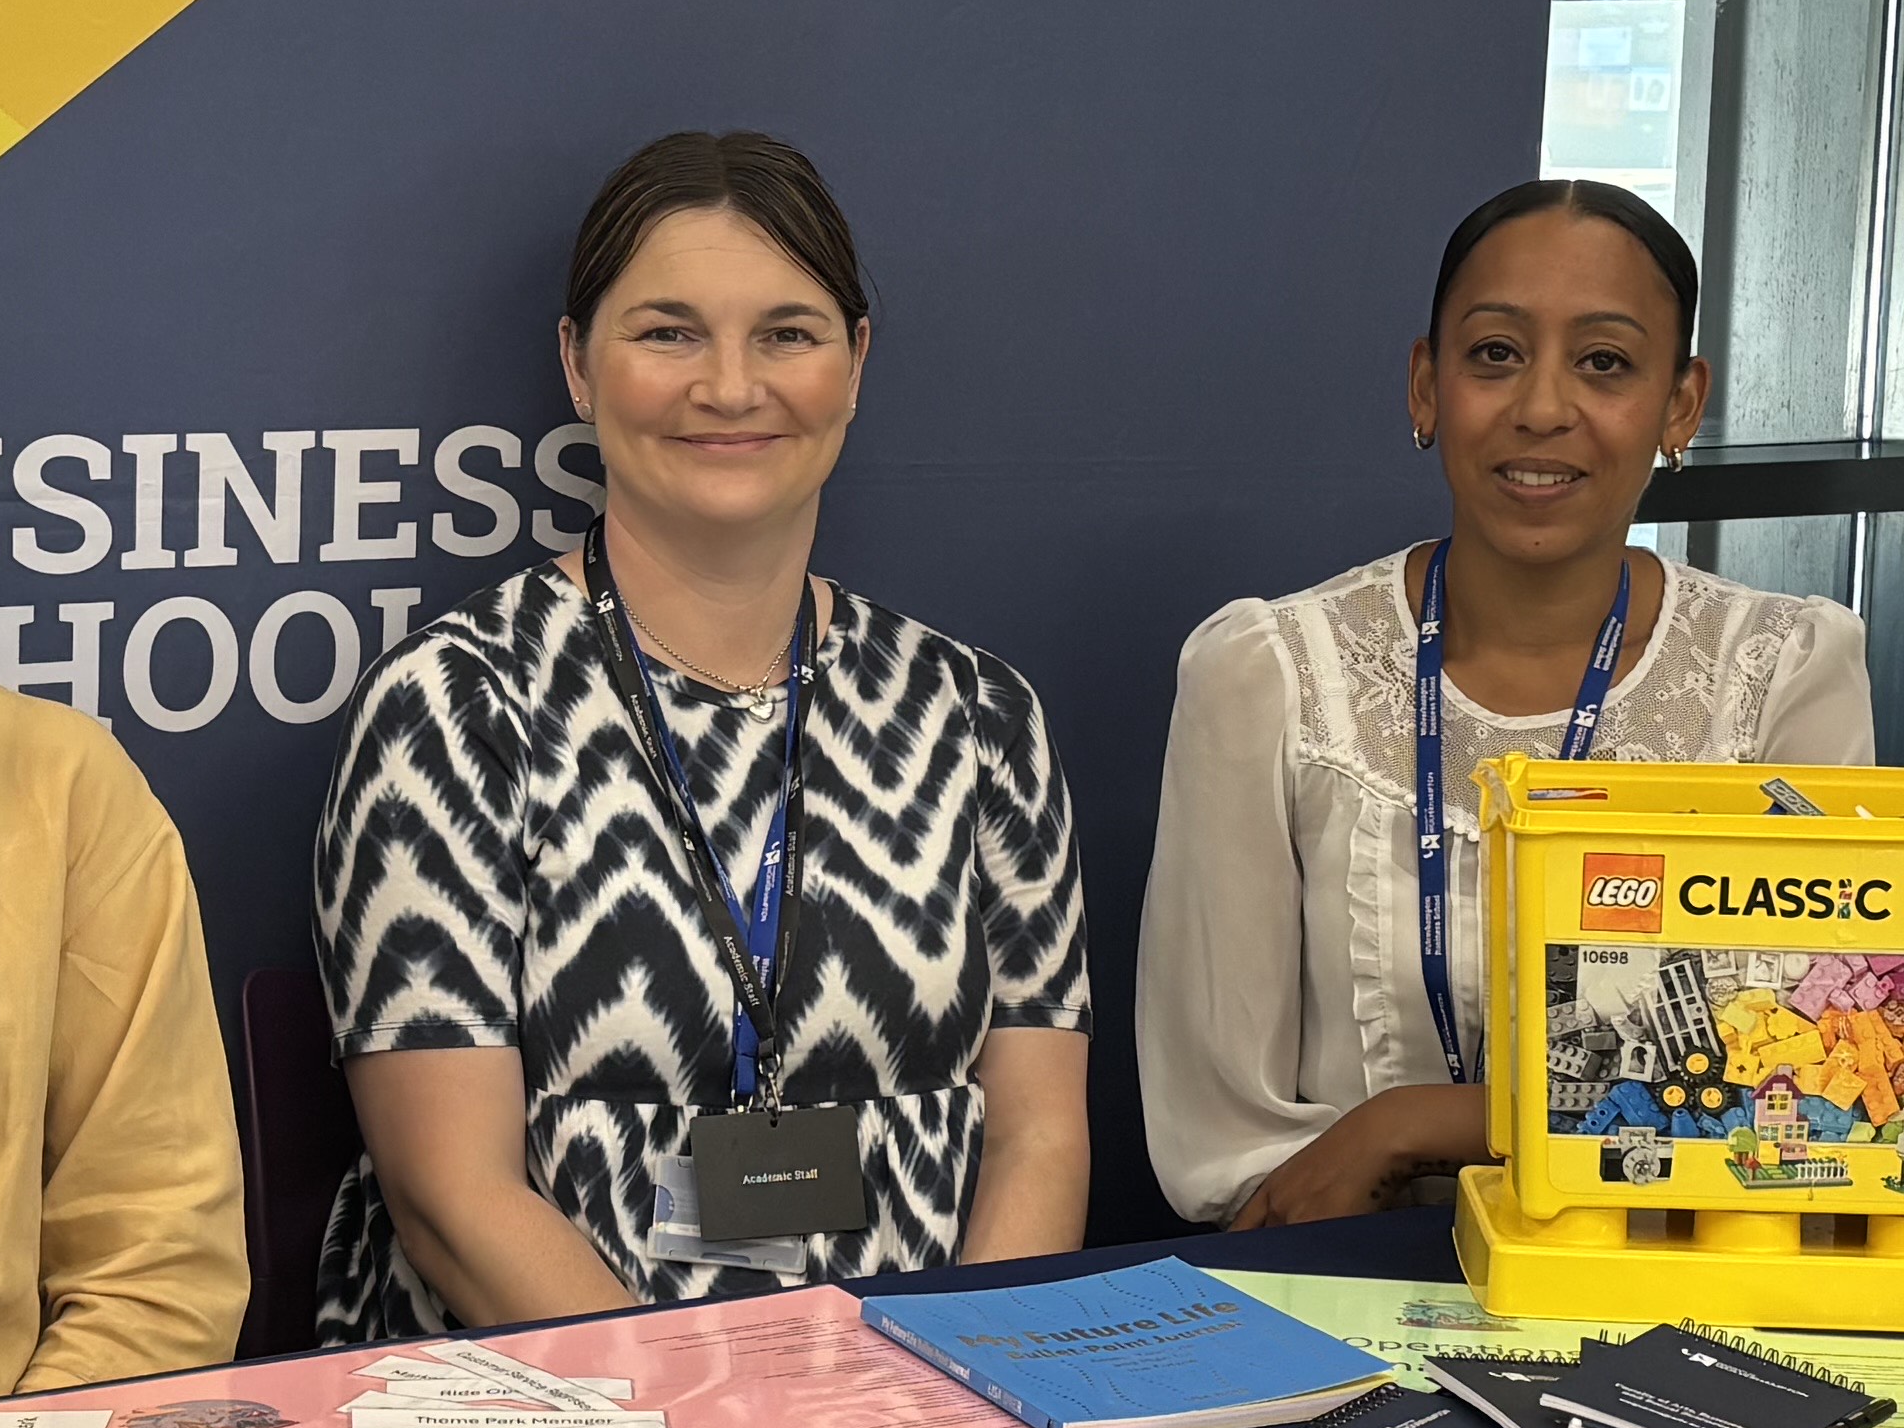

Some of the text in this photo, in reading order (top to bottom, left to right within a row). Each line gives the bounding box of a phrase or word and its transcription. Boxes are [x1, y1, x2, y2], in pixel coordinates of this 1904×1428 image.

[1587, 872, 1893, 922] LEGO CLASSIC
[723, 934, 759, 1008] Academic Staff
[1580, 948, 1630, 965] 10698
[742, 1168, 818, 1185] Academic Staff
[956, 1331, 1024, 1351] My
[1025, 1314, 1162, 1348] Future
[1160, 1299, 1241, 1327] Life
[416, 1415, 615, 1428] Theme Park Manager
